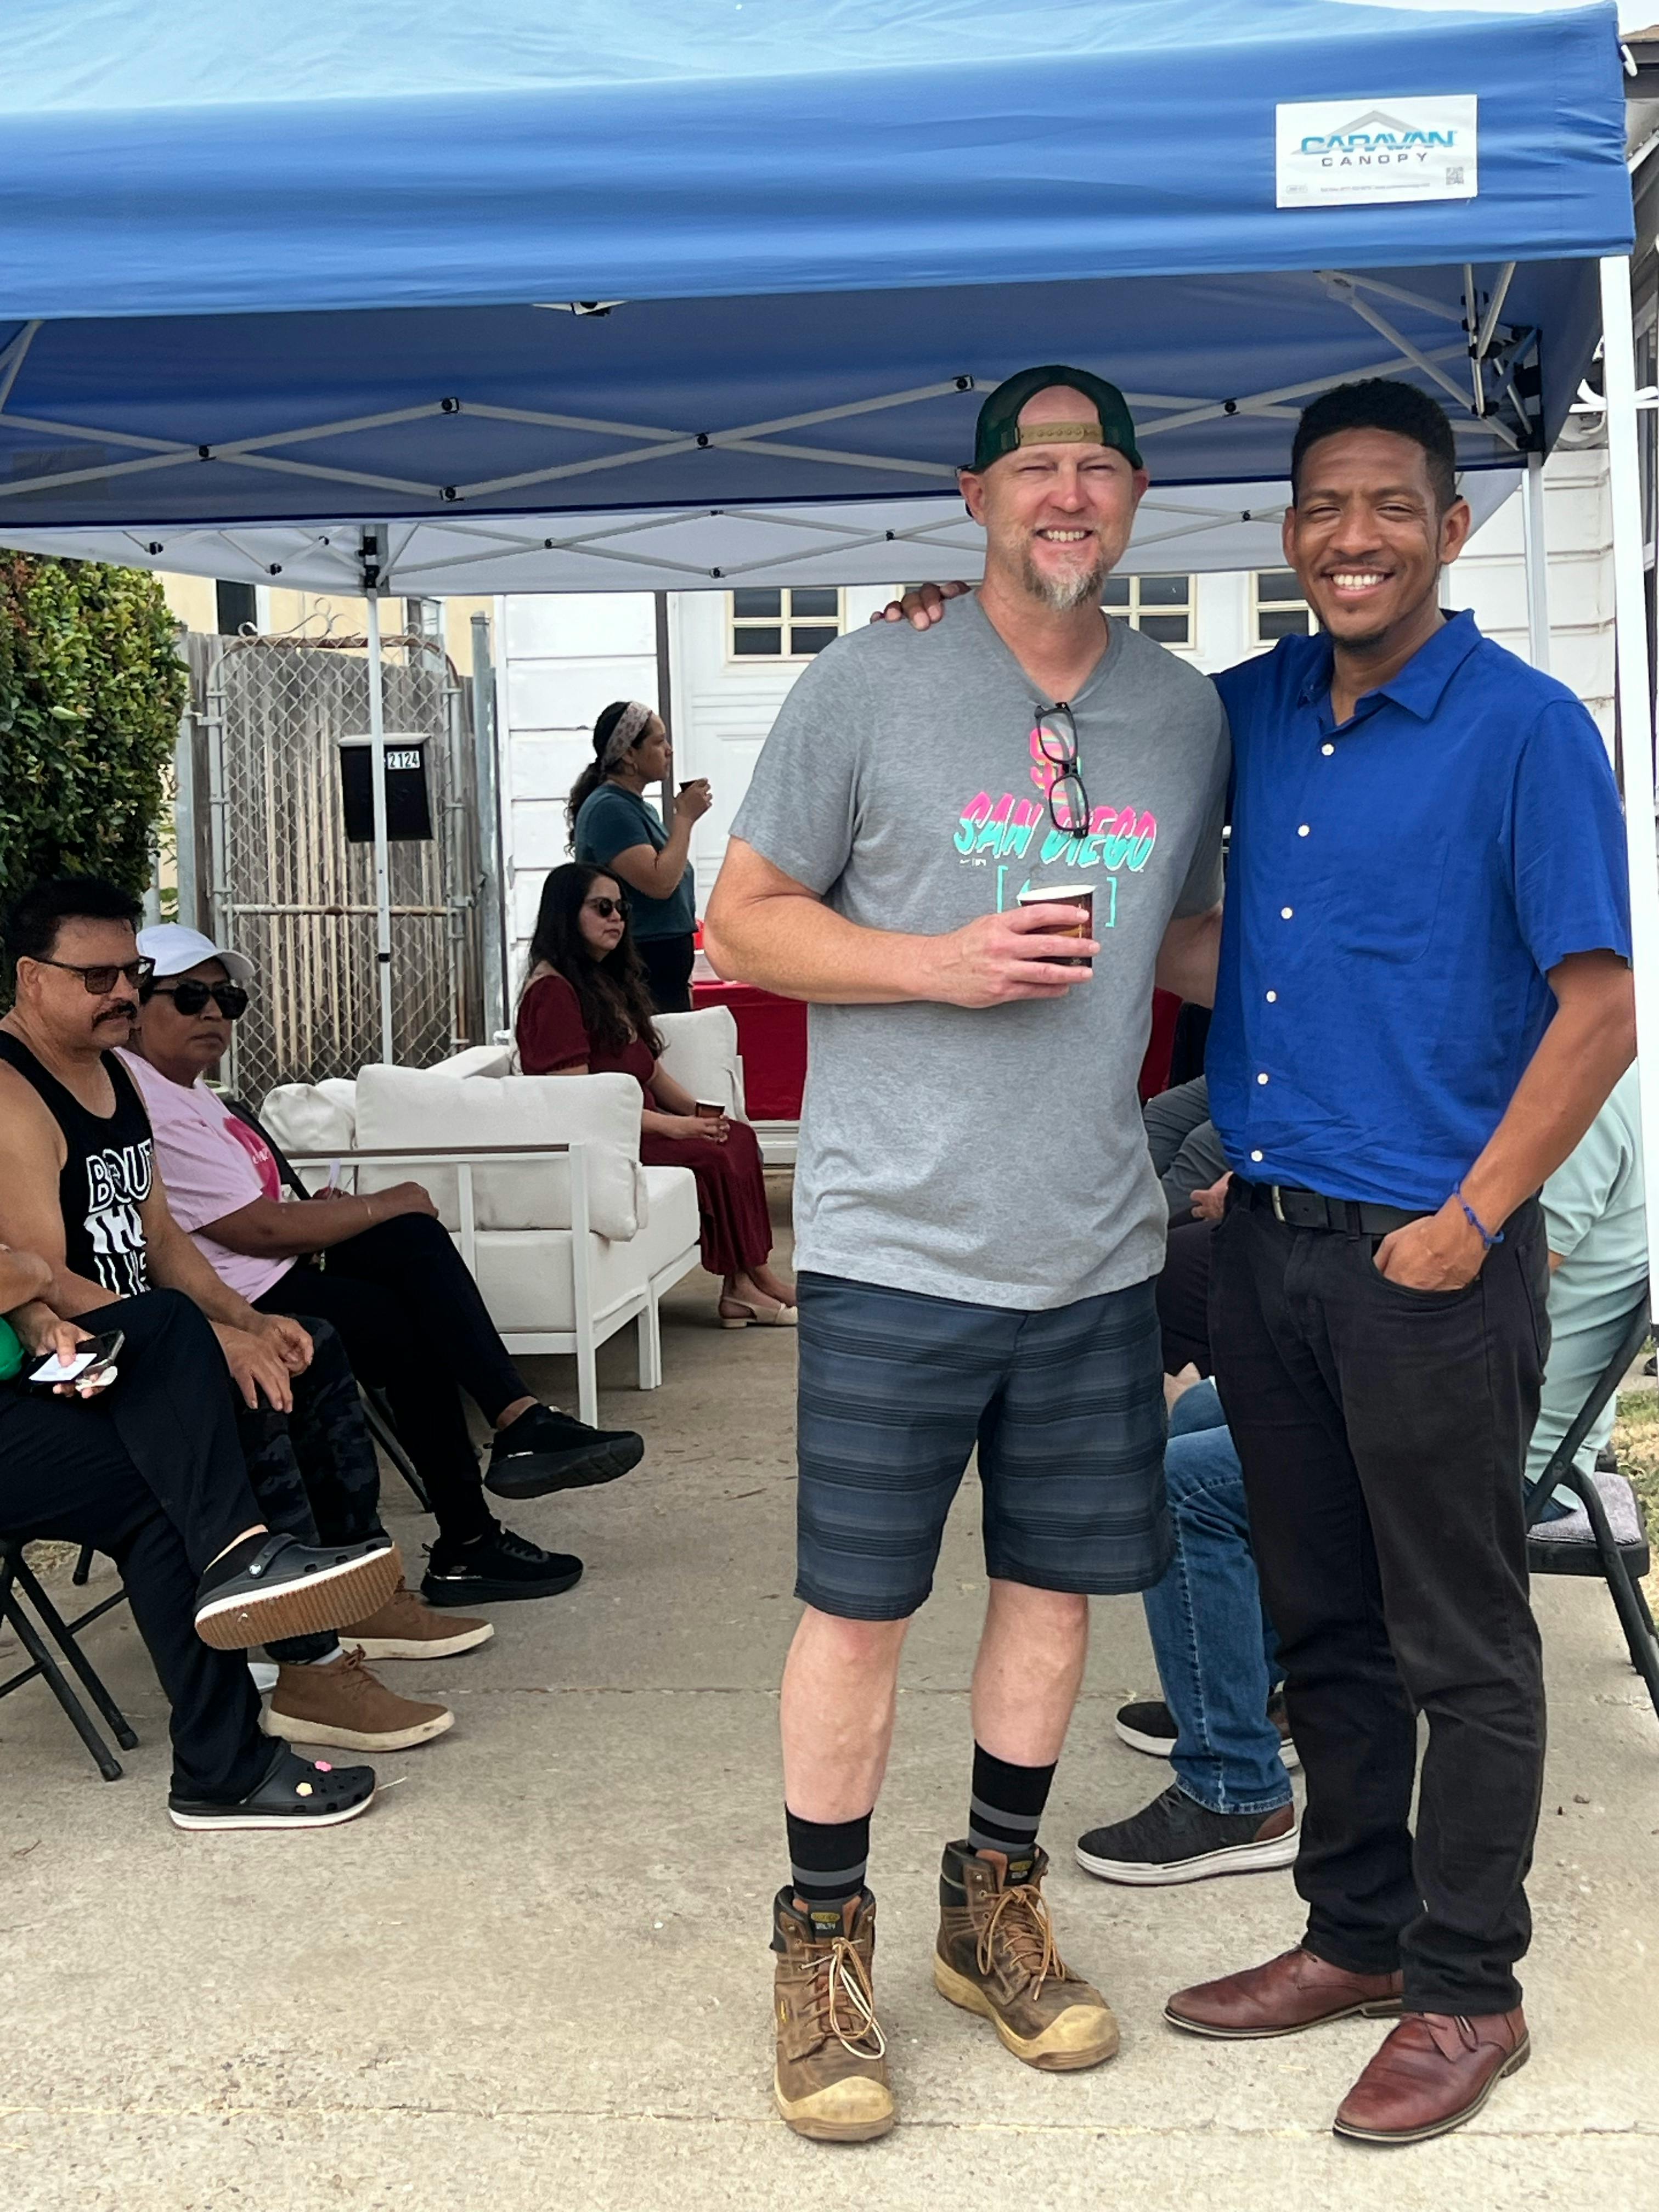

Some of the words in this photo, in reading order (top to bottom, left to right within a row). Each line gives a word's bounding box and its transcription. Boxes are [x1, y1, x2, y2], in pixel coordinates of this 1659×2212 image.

[1301, 131, 1454, 155] CARAVAN
[1321, 152, 1427, 167] CANOPY
[388, 752, 419, 768] 2124
[953, 791, 1044, 860] SAN
[1040, 805, 1157, 872] DIEGO
[86, 1138, 153, 1212] BOU
